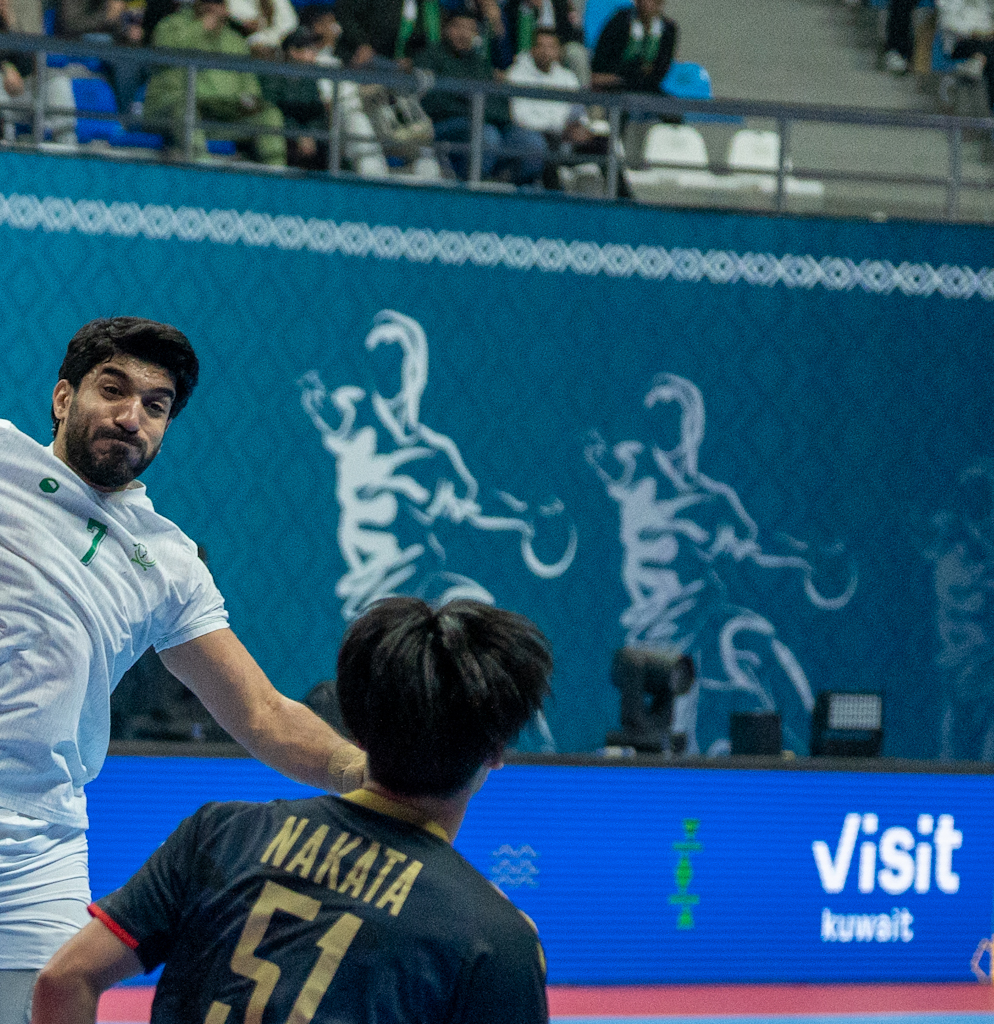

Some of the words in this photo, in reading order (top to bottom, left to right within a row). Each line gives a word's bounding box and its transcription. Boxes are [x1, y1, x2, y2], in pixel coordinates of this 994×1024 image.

[80, 517, 108, 566] 7
[260, 815, 424, 917] NAKATA
[820, 906, 915, 943] kuwait
